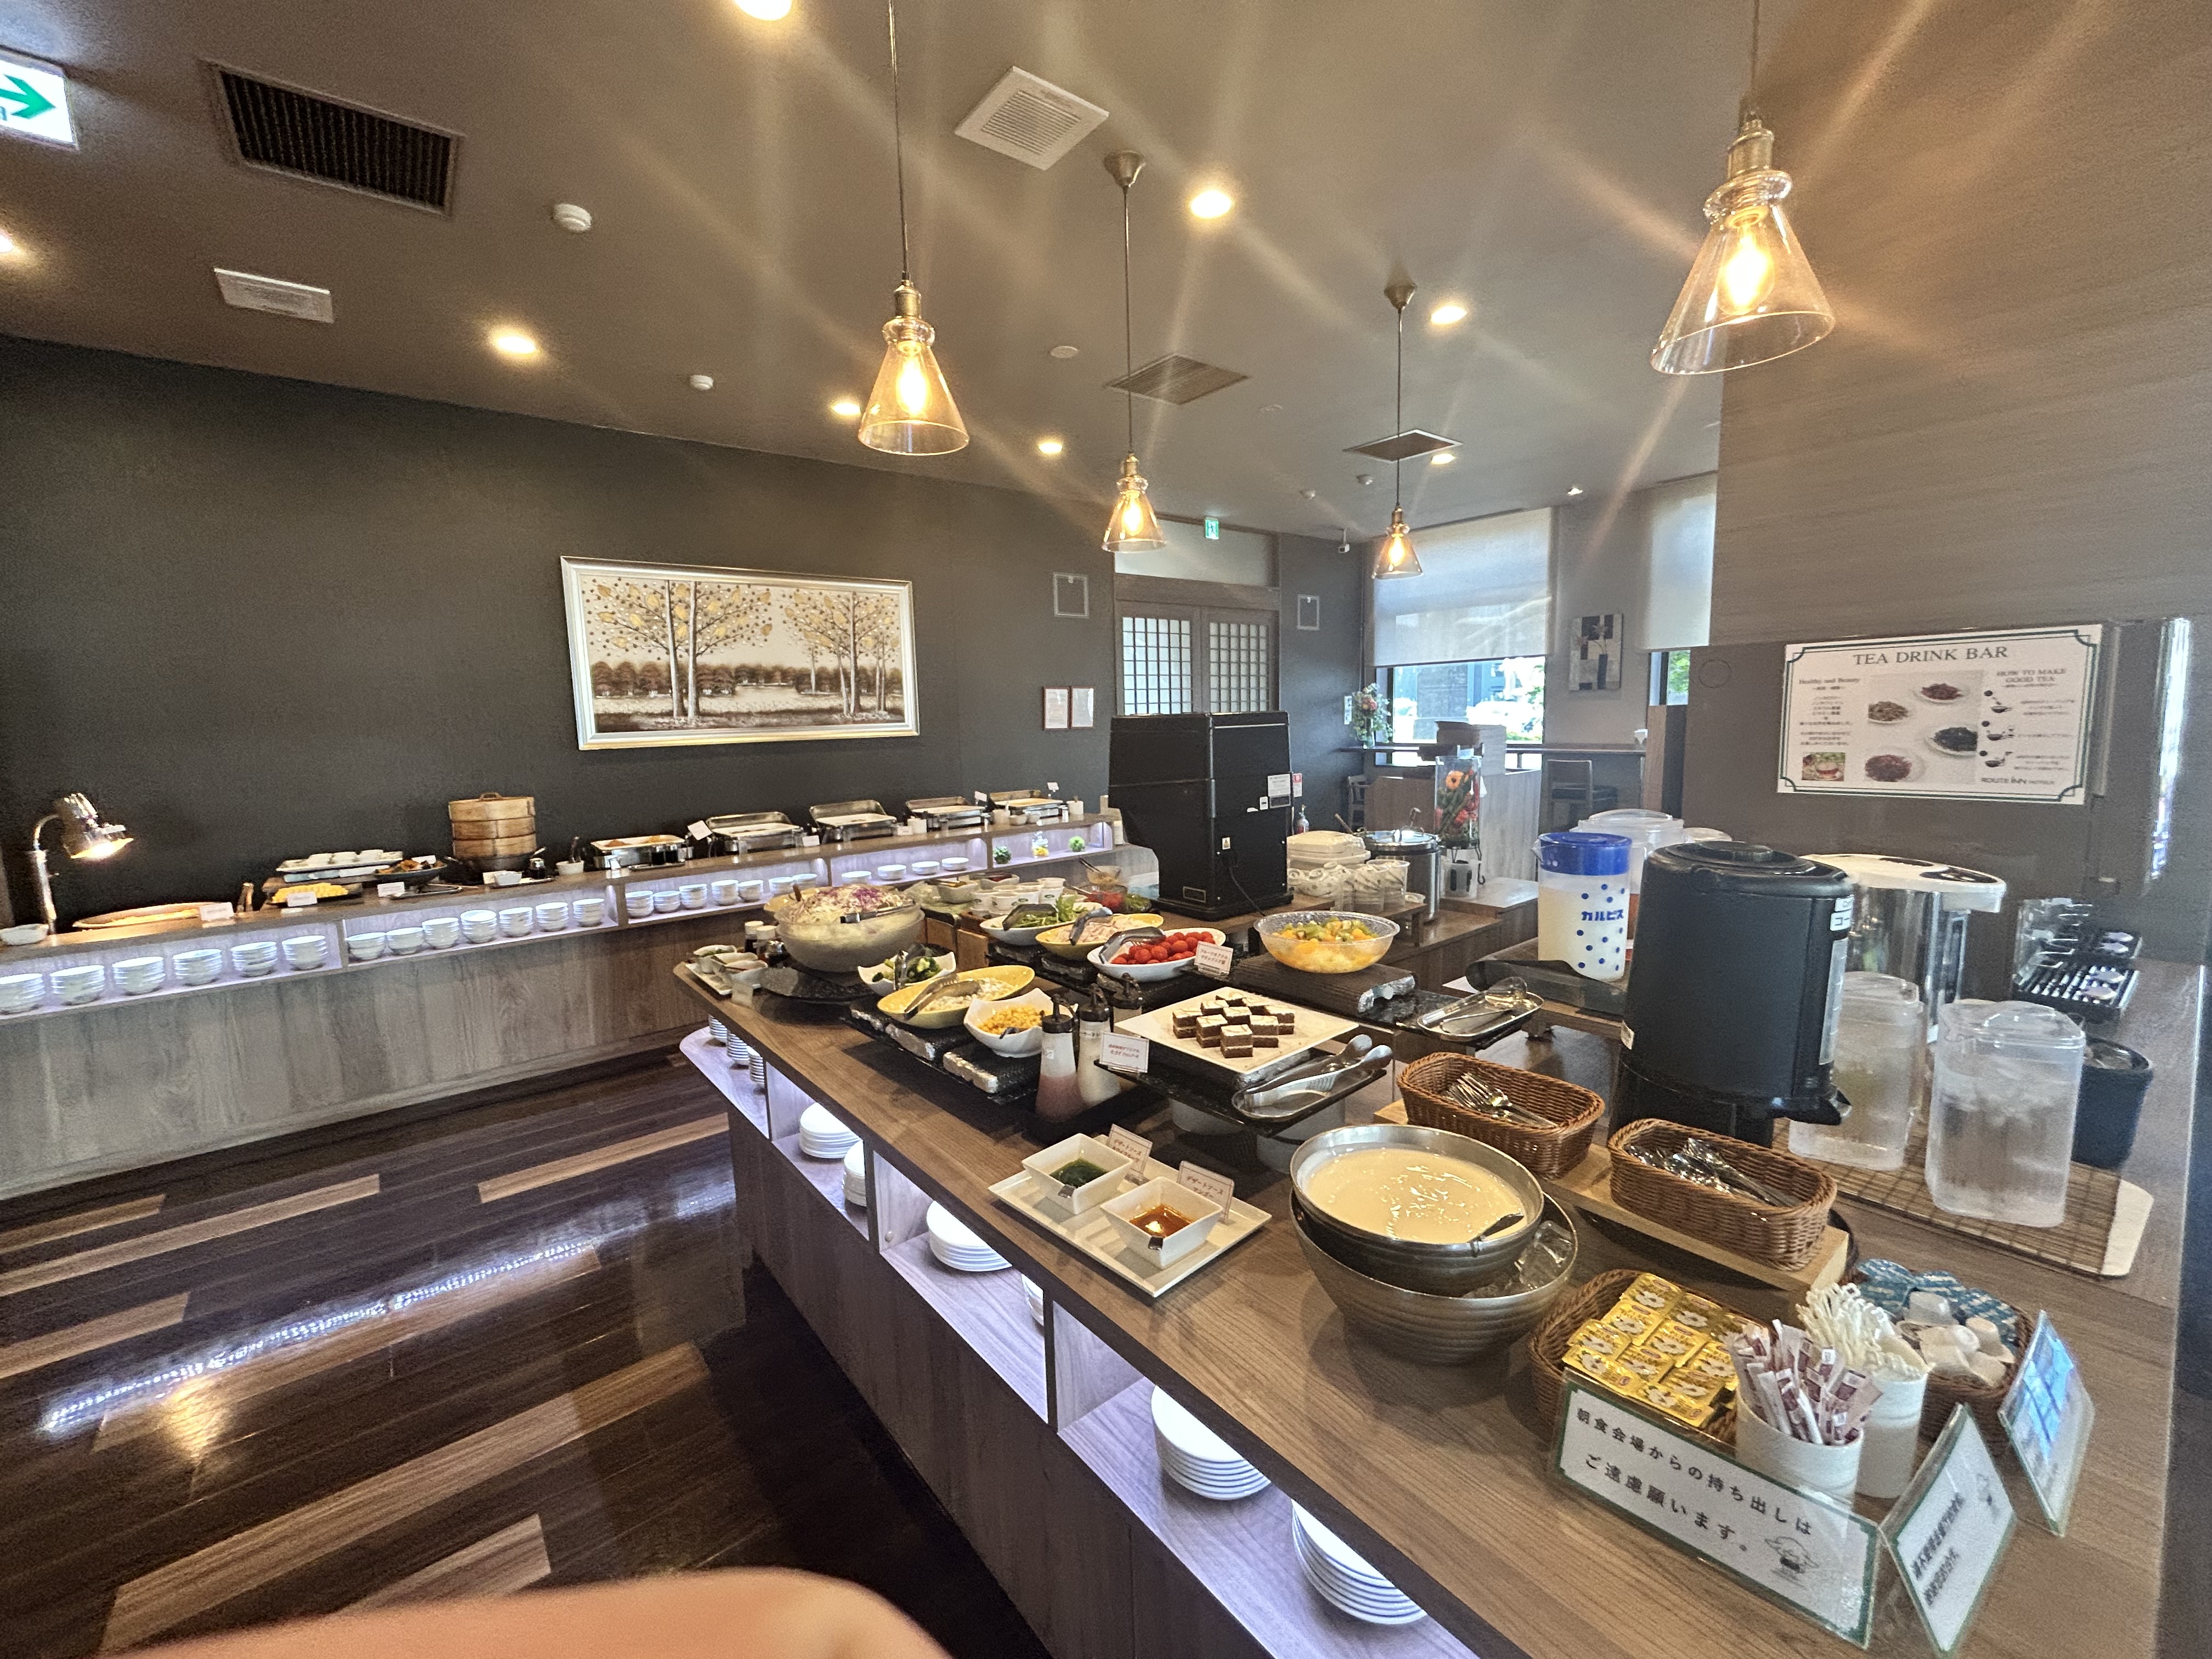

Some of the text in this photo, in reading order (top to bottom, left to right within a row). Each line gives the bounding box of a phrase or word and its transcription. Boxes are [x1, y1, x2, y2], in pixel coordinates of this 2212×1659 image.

[1853, 646, 2008, 666] TEA DRINK BAR
[1186, 1176, 1223, 1195] デザートソース
[1193, 1187, 1214, 1198] マンゴー
[1576, 1407, 1812, 1536] 朝食会場からの持ち出しは
[1585, 1452, 1749, 1552] ご遠慮願います。
